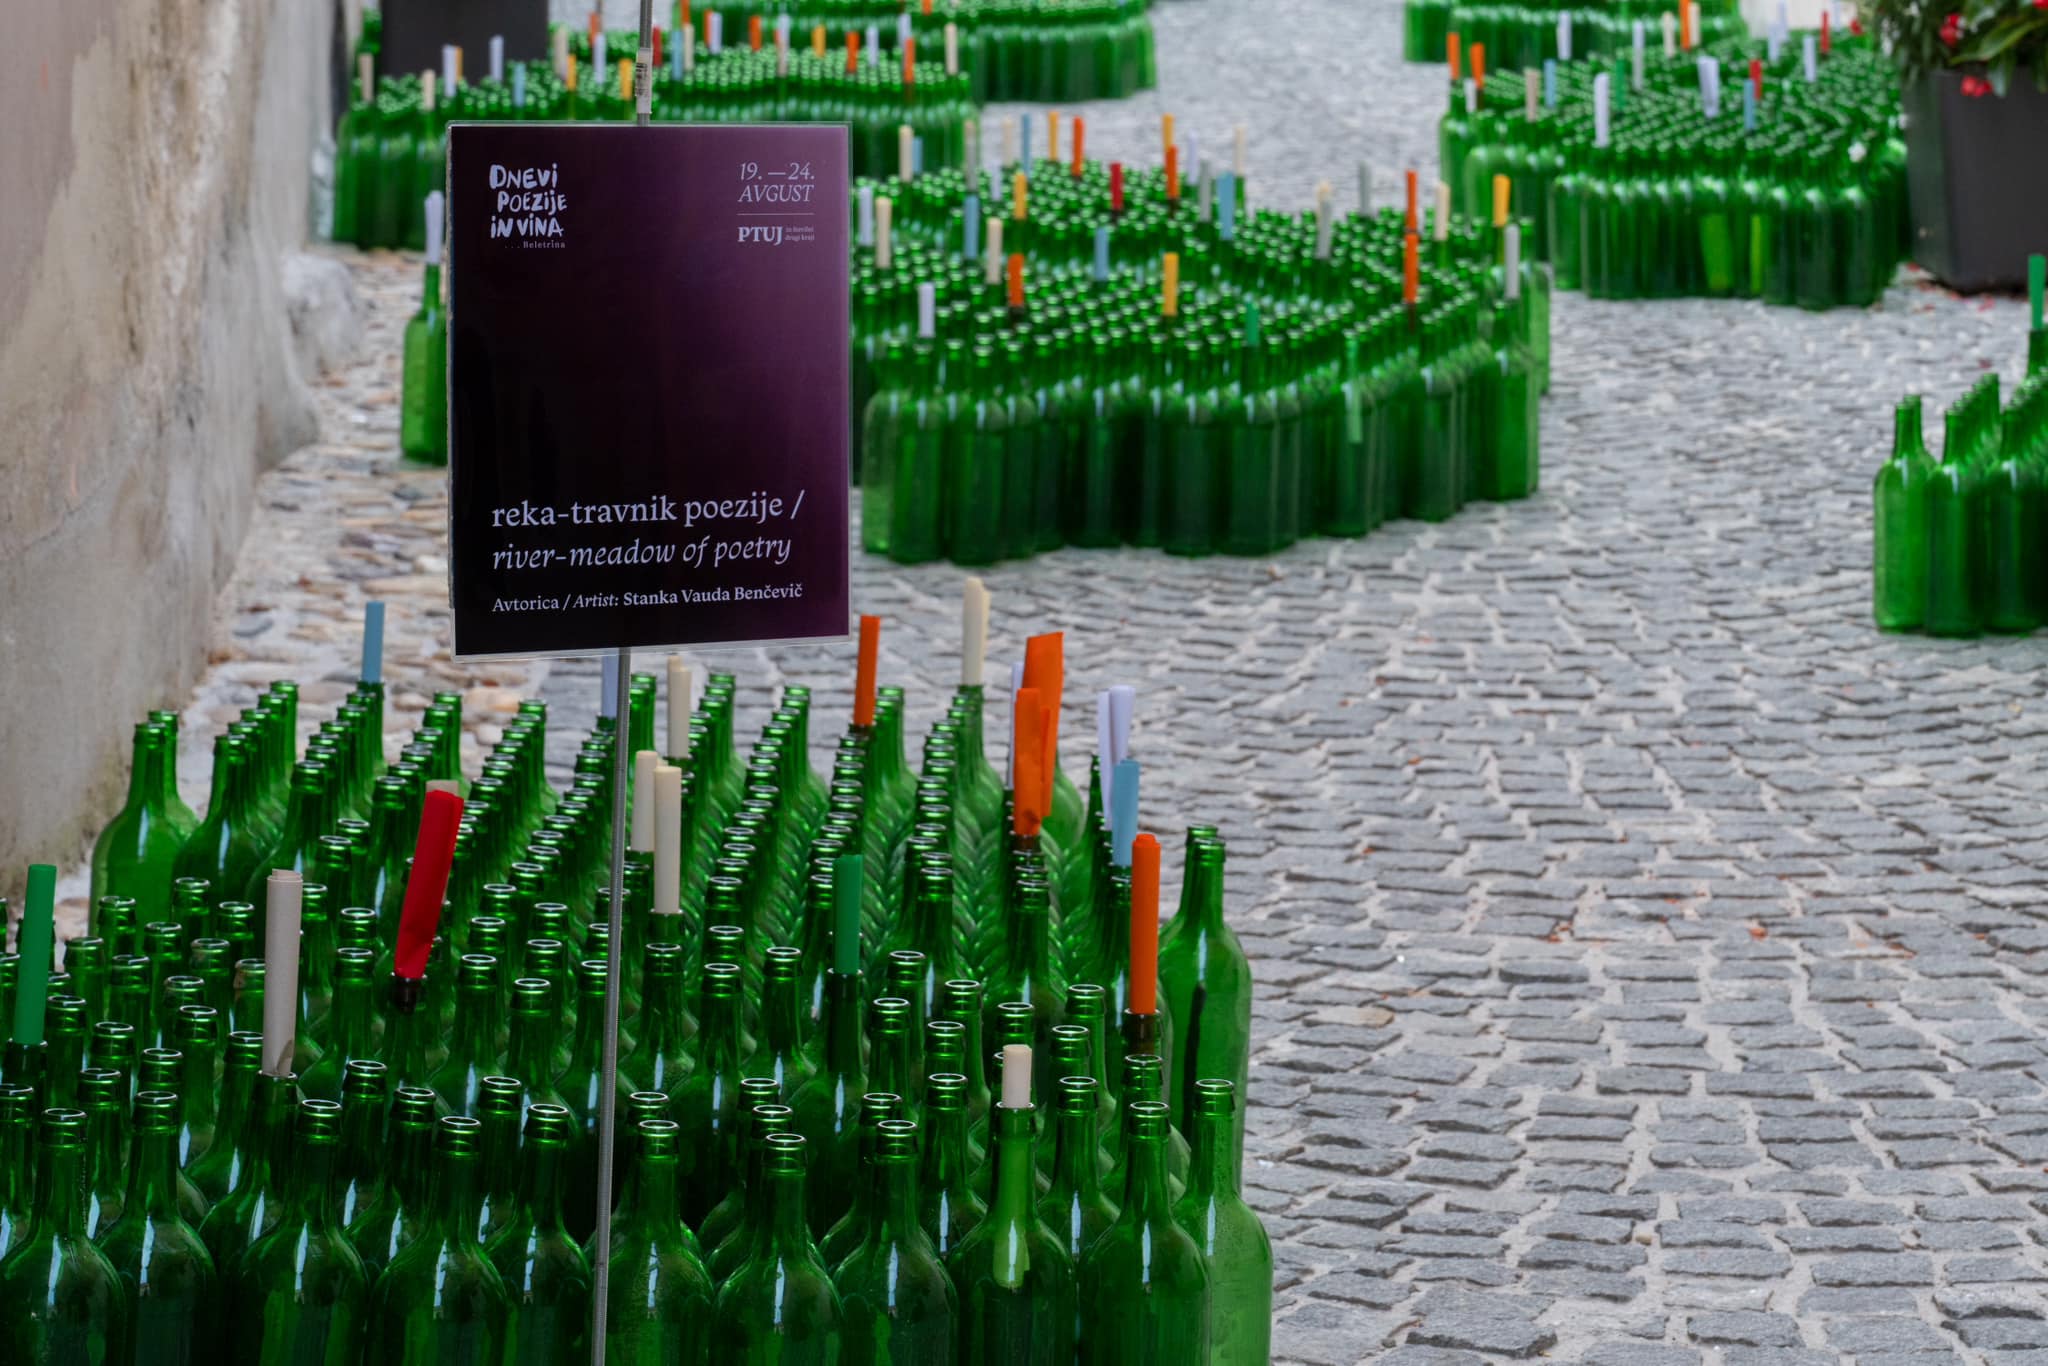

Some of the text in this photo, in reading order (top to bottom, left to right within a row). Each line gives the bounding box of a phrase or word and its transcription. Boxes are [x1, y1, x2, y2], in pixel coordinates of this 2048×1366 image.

[737, 185, 815, 202] AVGUST
[738, 226, 783, 246] PTUJ
[492, 489, 805, 527] reka-travnik poezije /
[492, 535, 791, 570] river-meadow of poetry
[492, 583, 803, 612] Avtorica / Artist: Stanka Vauda Benčevič
